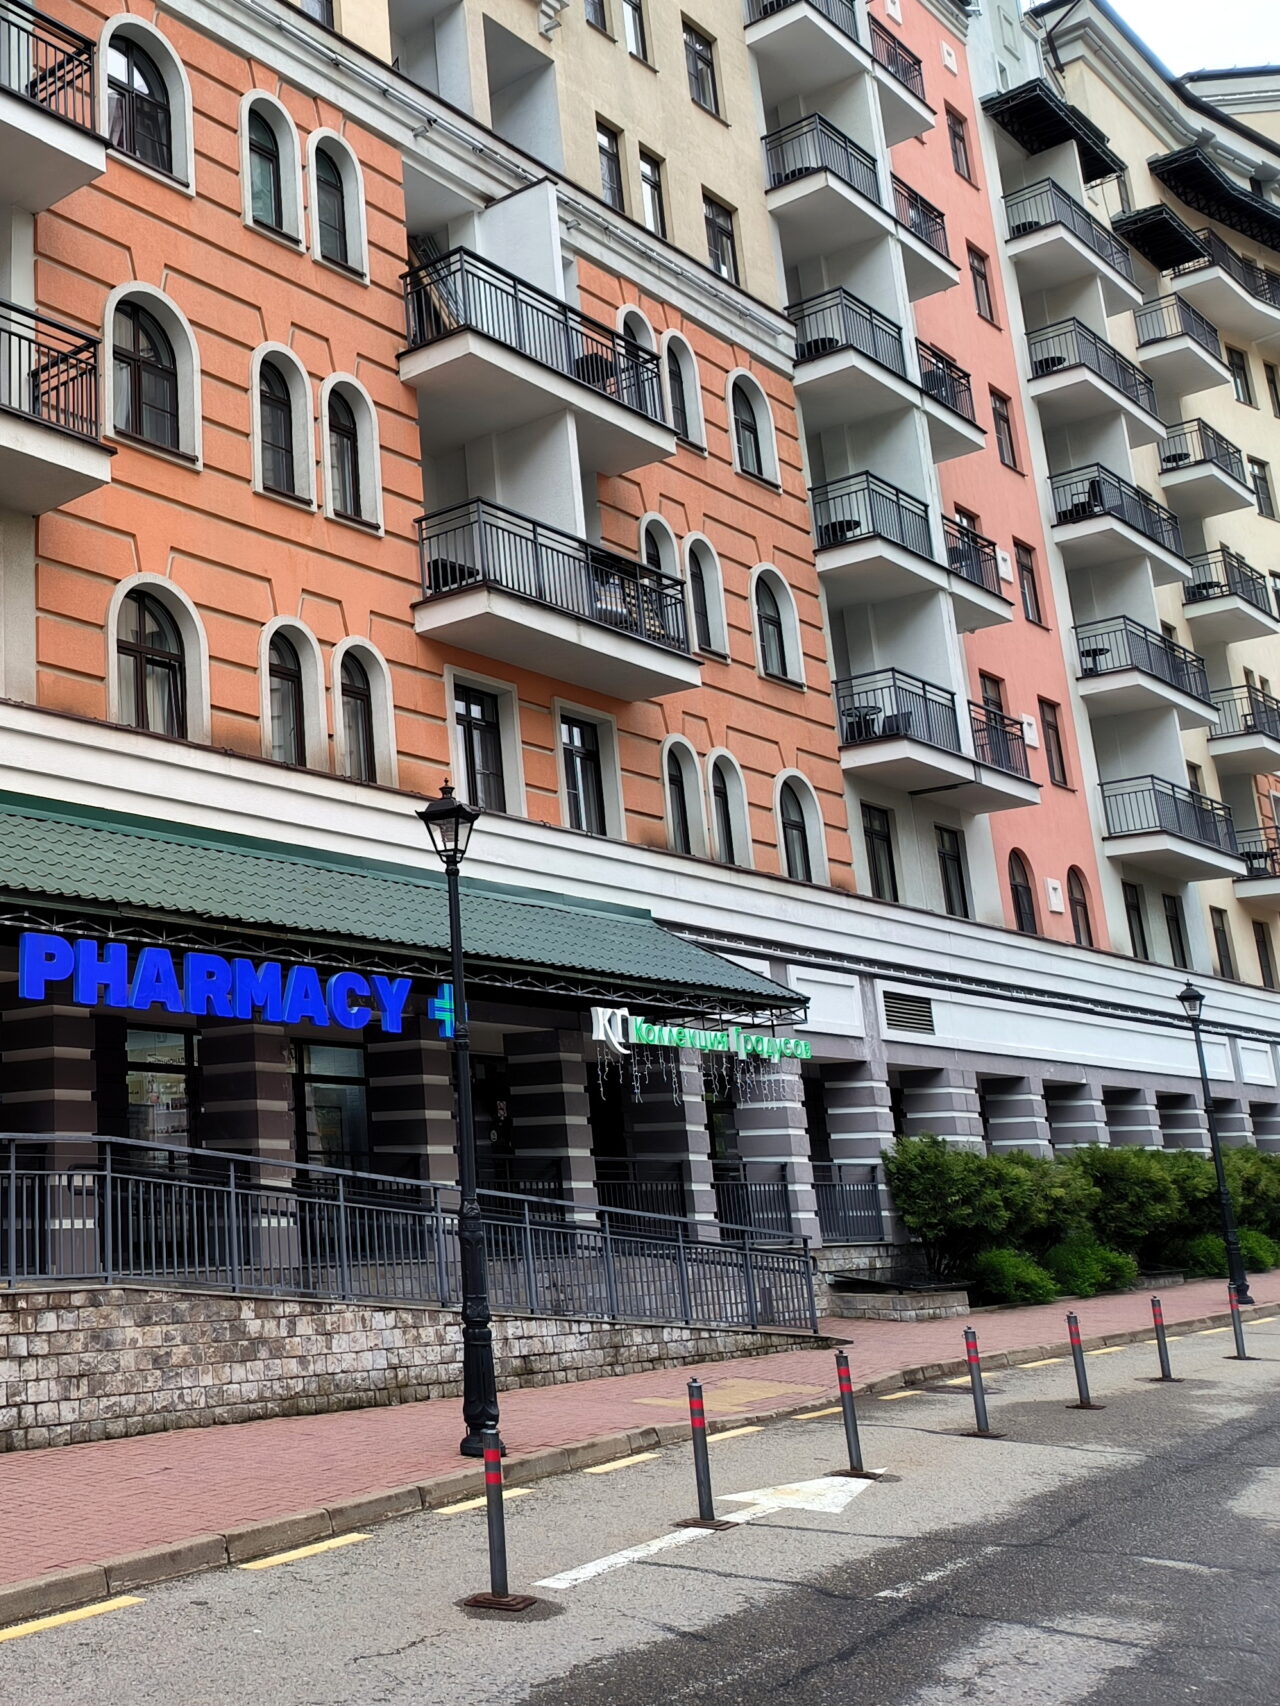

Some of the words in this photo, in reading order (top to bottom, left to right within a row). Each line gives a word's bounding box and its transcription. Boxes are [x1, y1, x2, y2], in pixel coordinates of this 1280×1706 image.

[19, 932, 411, 1034] PHARMACY
[628, 1016, 730, 1053] Коллекция
[728, 1027, 813, 1063] Градусов
